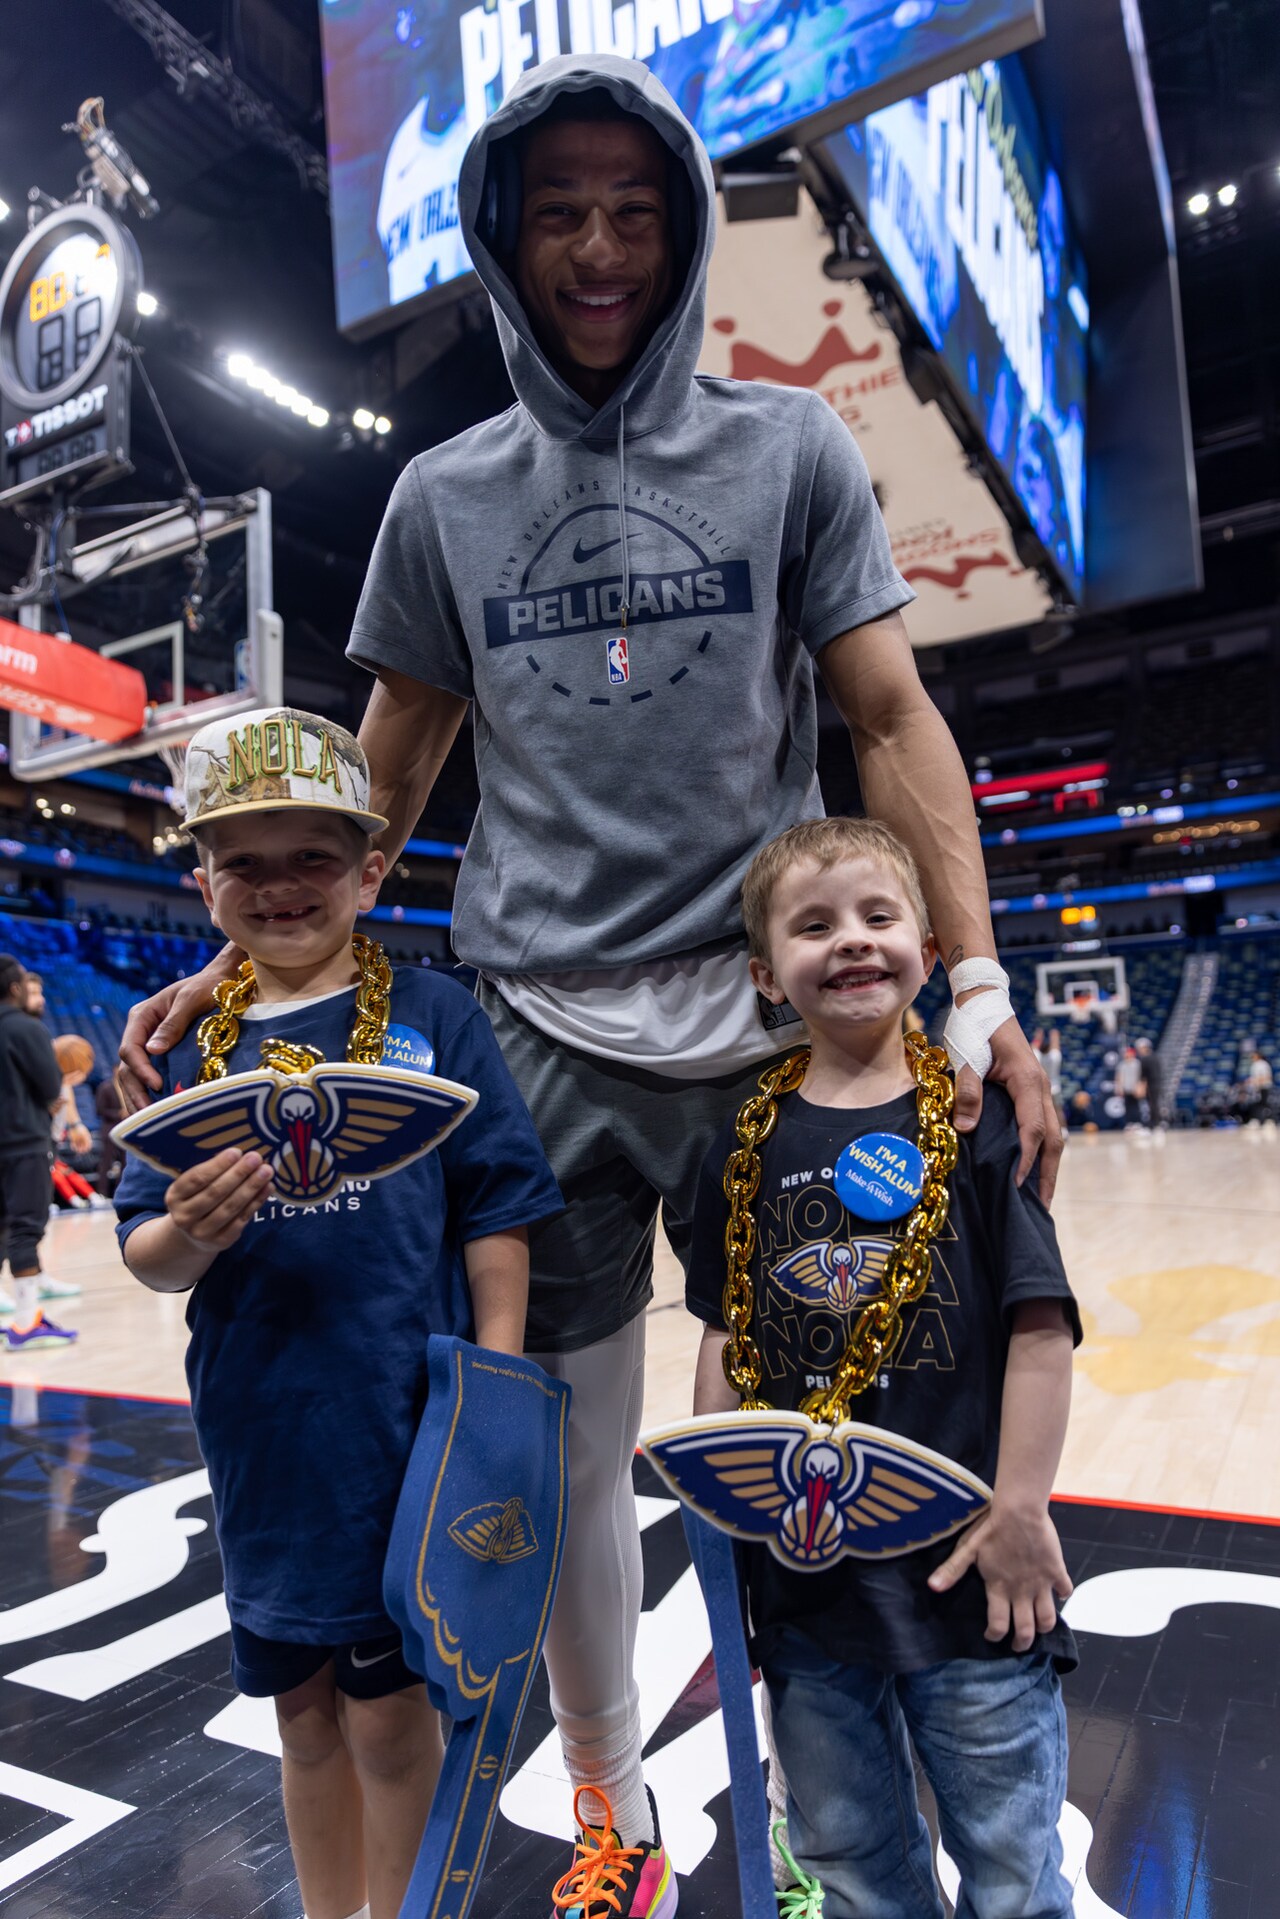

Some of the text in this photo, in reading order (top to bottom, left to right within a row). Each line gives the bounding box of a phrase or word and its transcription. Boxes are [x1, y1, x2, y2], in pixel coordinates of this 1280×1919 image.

[497, 555, 518, 590] NEW
[523, 480, 600, 541] ORLEANS
[508, 570, 726, 637] PELICANS
[227, 718, 343, 794] NOLA
[781, 1170, 814, 1189] NEW
[848, 1144, 884, 1174] WISH
[880, 1168, 921, 1200] ALUM
[875, 1145, 907, 1173] I'M A
[761, 1308, 956, 1379] NOA
